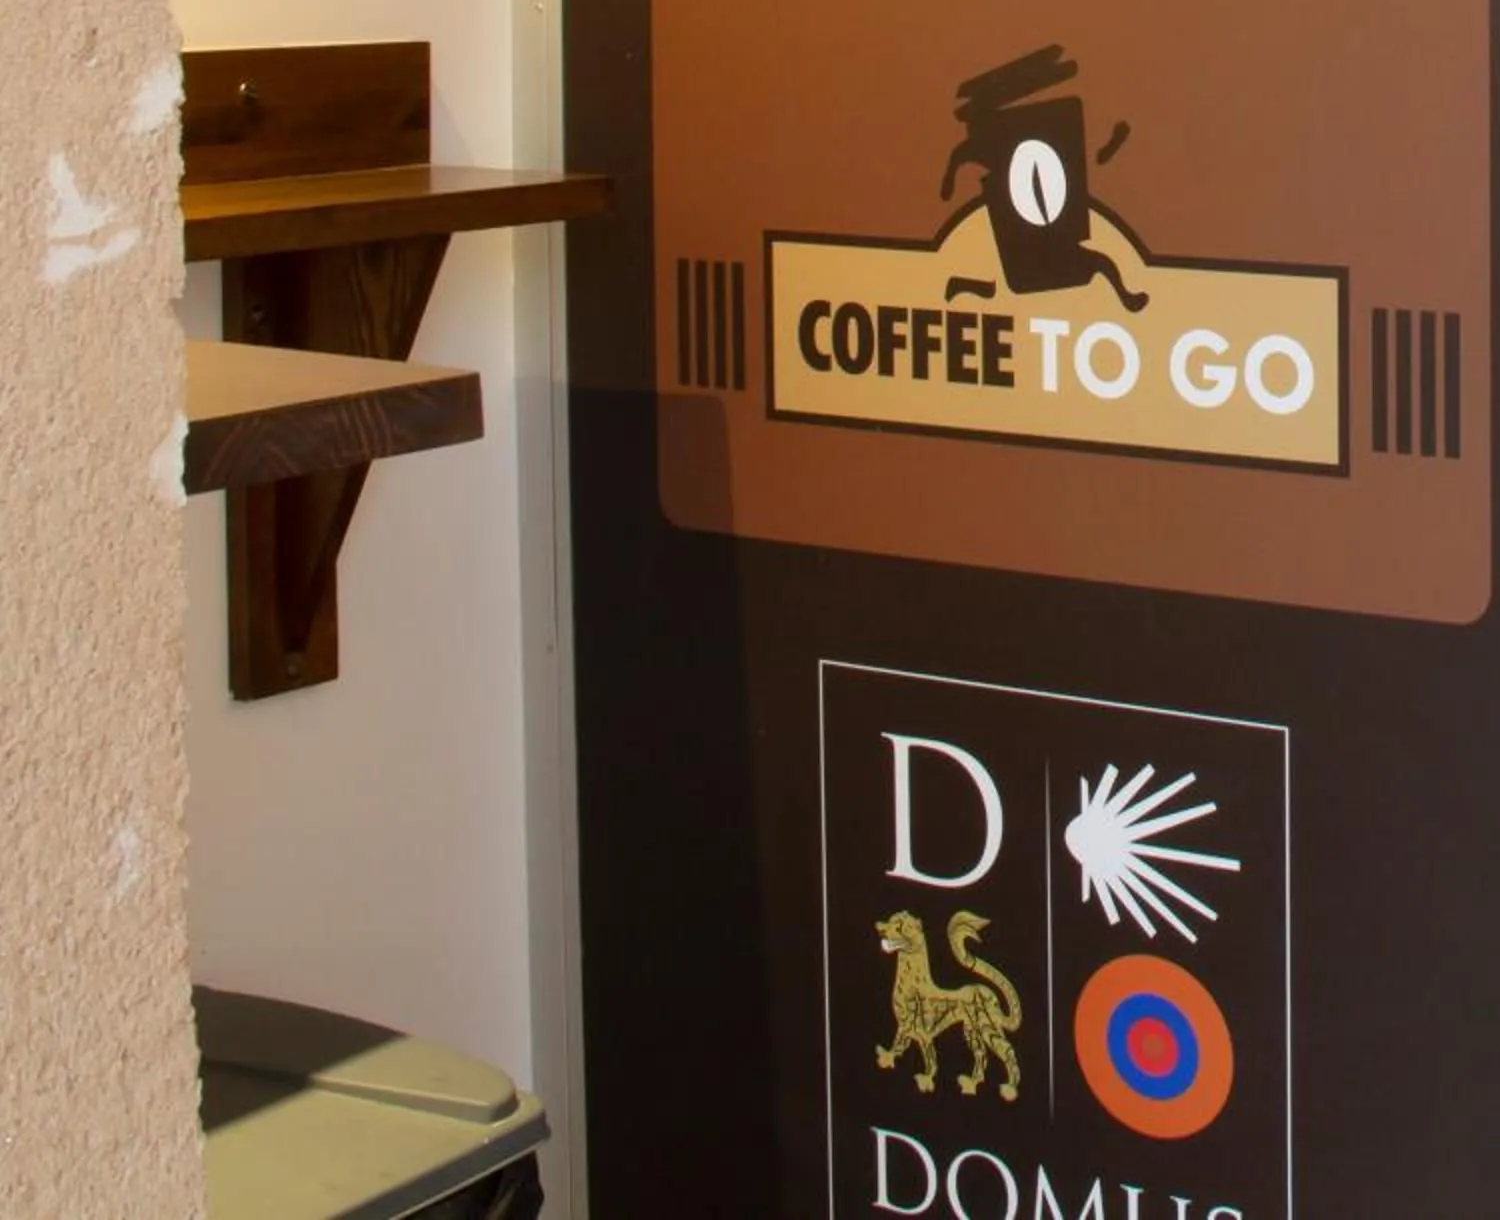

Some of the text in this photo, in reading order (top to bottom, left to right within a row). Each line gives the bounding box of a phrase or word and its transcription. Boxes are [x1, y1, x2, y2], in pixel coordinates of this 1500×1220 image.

[798, 299, 1316, 416] COFFEE TO GO
[881, 731, 1004, 889] D
[870, 1125, 1245, 1220] DOM
